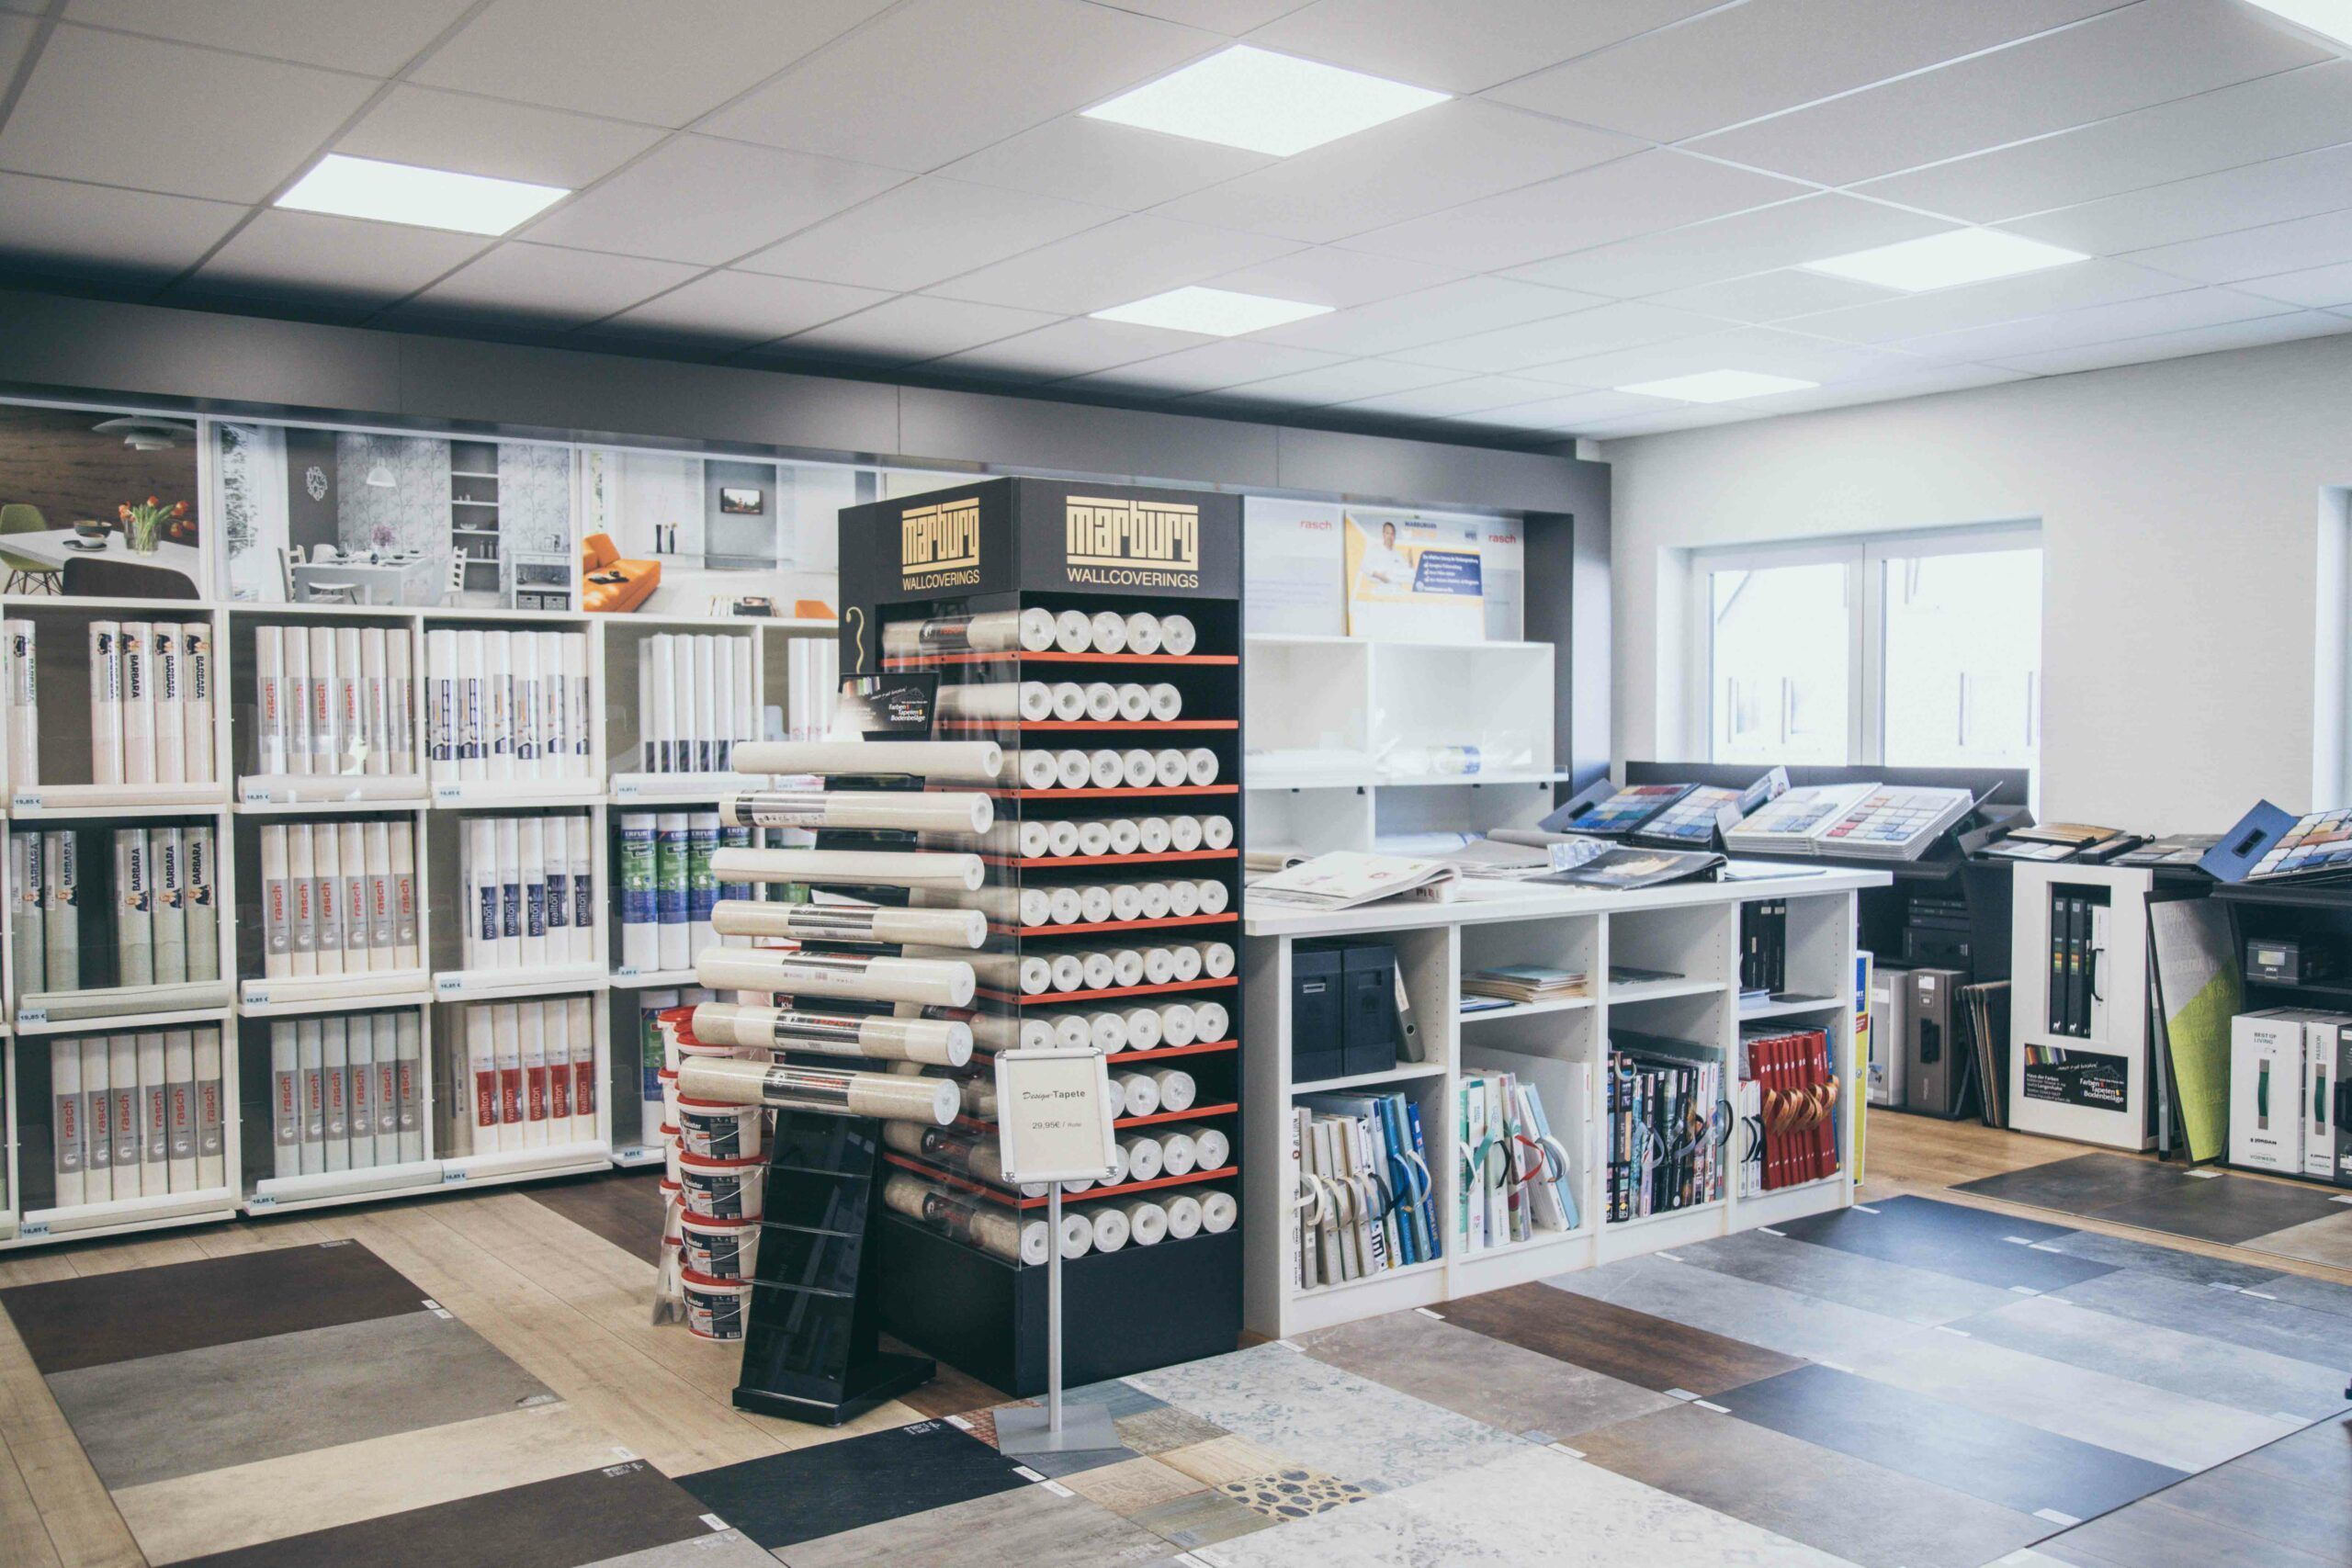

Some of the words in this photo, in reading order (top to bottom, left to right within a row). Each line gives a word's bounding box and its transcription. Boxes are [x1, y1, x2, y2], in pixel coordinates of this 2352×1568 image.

[902, 497, 980, 575] marburg
[1066, 495, 1199, 570] marburg
[1300, 519, 1332, 531] rasch
[1488, 532, 1517, 545] rasch
[902, 570, 980, 592] WALLCOVERINGS
[1067, 568, 1199, 589] WALLCOVERINGS
[130, 654, 140, 698] BARBARA
[165, 655, 175, 699] BARBARA
[196, 655, 205, 699] BARBARA
[266, 683, 275, 720] rasch
[317, 683, 326, 720] rasch
[345, 684, 355, 720] rasch
[31, 840, 40, 888] BARBARA
[64, 841, 73, 886] BARBARA
[131, 848, 141, 891] BARBARA
[166, 845, 175, 888] BARBARA
[192, 842, 201, 885] BARBARA
[272, 885, 282, 921] rasch
[300, 884, 309, 919] rasch
[322, 882, 331, 918] rasch
[353, 882, 362, 917] rasch
[375, 880, 385, 915] rasch
[400, 878, 410, 915] rasch
[550, 893, 560, 926] wallton
[578, 893, 587, 926] wallton
[484, 904, 493, 940] wallton
[506, 902, 515, 936] wallton
[530, 902, 539, 936] wallton
[812, 1016, 855, 1027] rasch
[282, 1077, 291, 1113] rasch
[311, 1074, 320, 1110] rasch
[331, 1072, 341, 1108] rasch
[355, 1069, 365, 1106] rasch
[382, 1066, 391, 1102] rasch
[401, 1066, 410, 1100] rasch
[580, 1080, 588, 1114] wallton
[2079, 1077, 2100, 1087] Farben
[2083, 1089, 2124, 1103] Bodenbeläge
[2091, 1085, 2116, 1094] Tapeten
[96, 1097, 107, 1134] rasch
[119, 1094, 130, 1132] rasch
[153, 1090, 163, 1128] rasch
[175, 1088, 186, 1126] rasch
[205, 1086, 215, 1123] rasch
[481, 1091, 490, 1125] wallton
[505, 1089, 514, 1122] wallton
[532, 1087, 540, 1120] wallton
[555, 1084, 563, 1117] wallton
[63, 1100, 74, 1139] rasch
